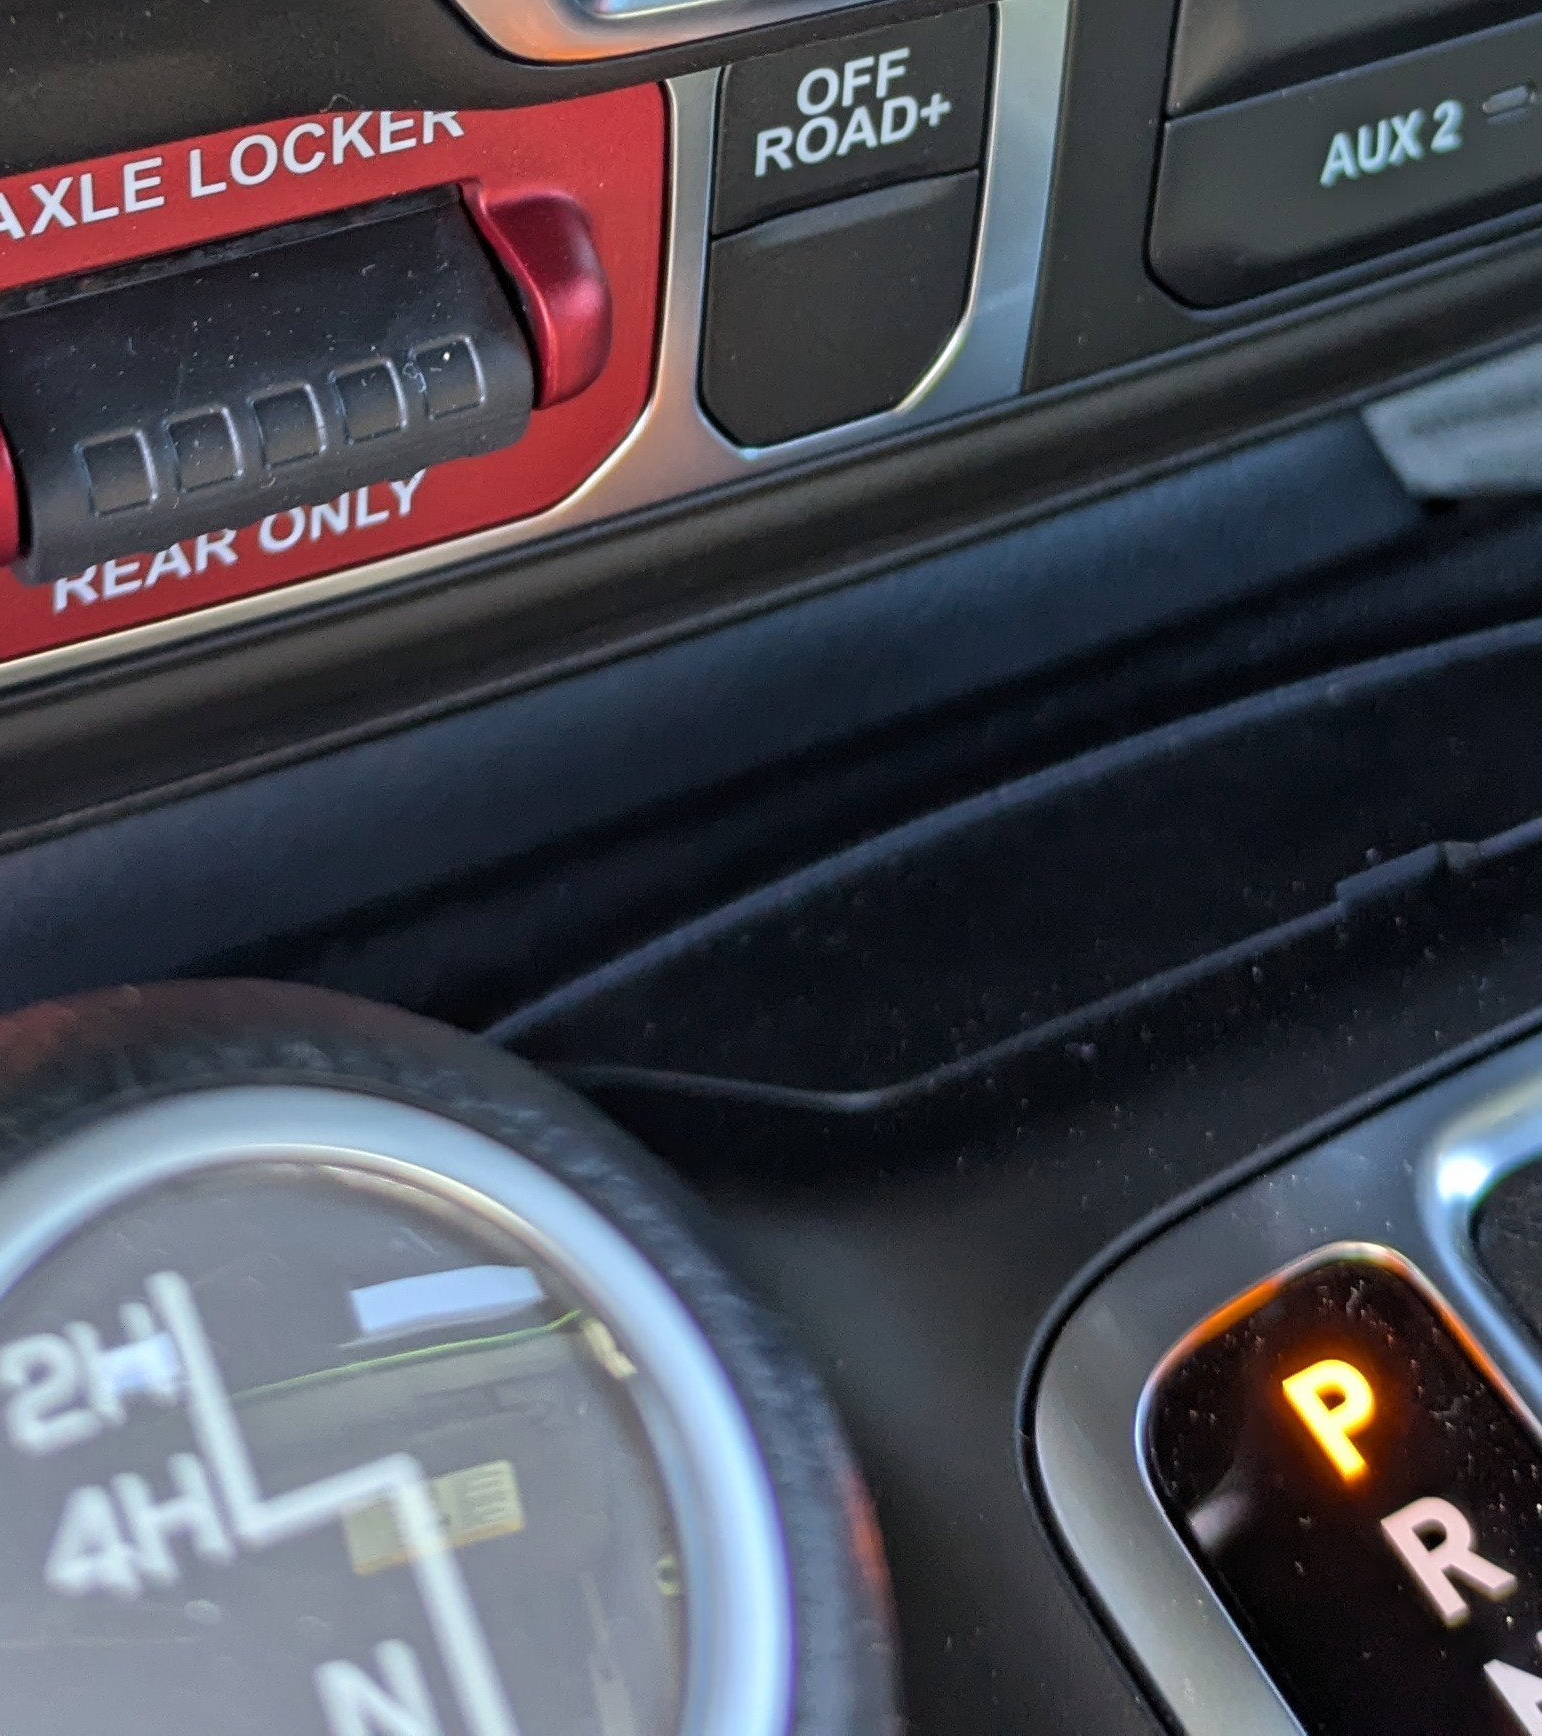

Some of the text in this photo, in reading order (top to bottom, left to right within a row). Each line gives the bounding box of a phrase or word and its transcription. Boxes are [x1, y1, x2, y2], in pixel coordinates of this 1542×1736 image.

[797, 48, 912, 117] OFF
[189, 110, 464, 199] LOCKER
[754, 97, 950, 177] ROAD+
[1320, 100, 1464, 185] AUX 2
[53, 467, 427, 614] REAR ONLY
[1282, 1358, 1375, 1483] P
[43, 1453, 235, 1599] 4H
[1380, 1496, 1518, 1628] R
[315, 1640, 449, 1736] N
